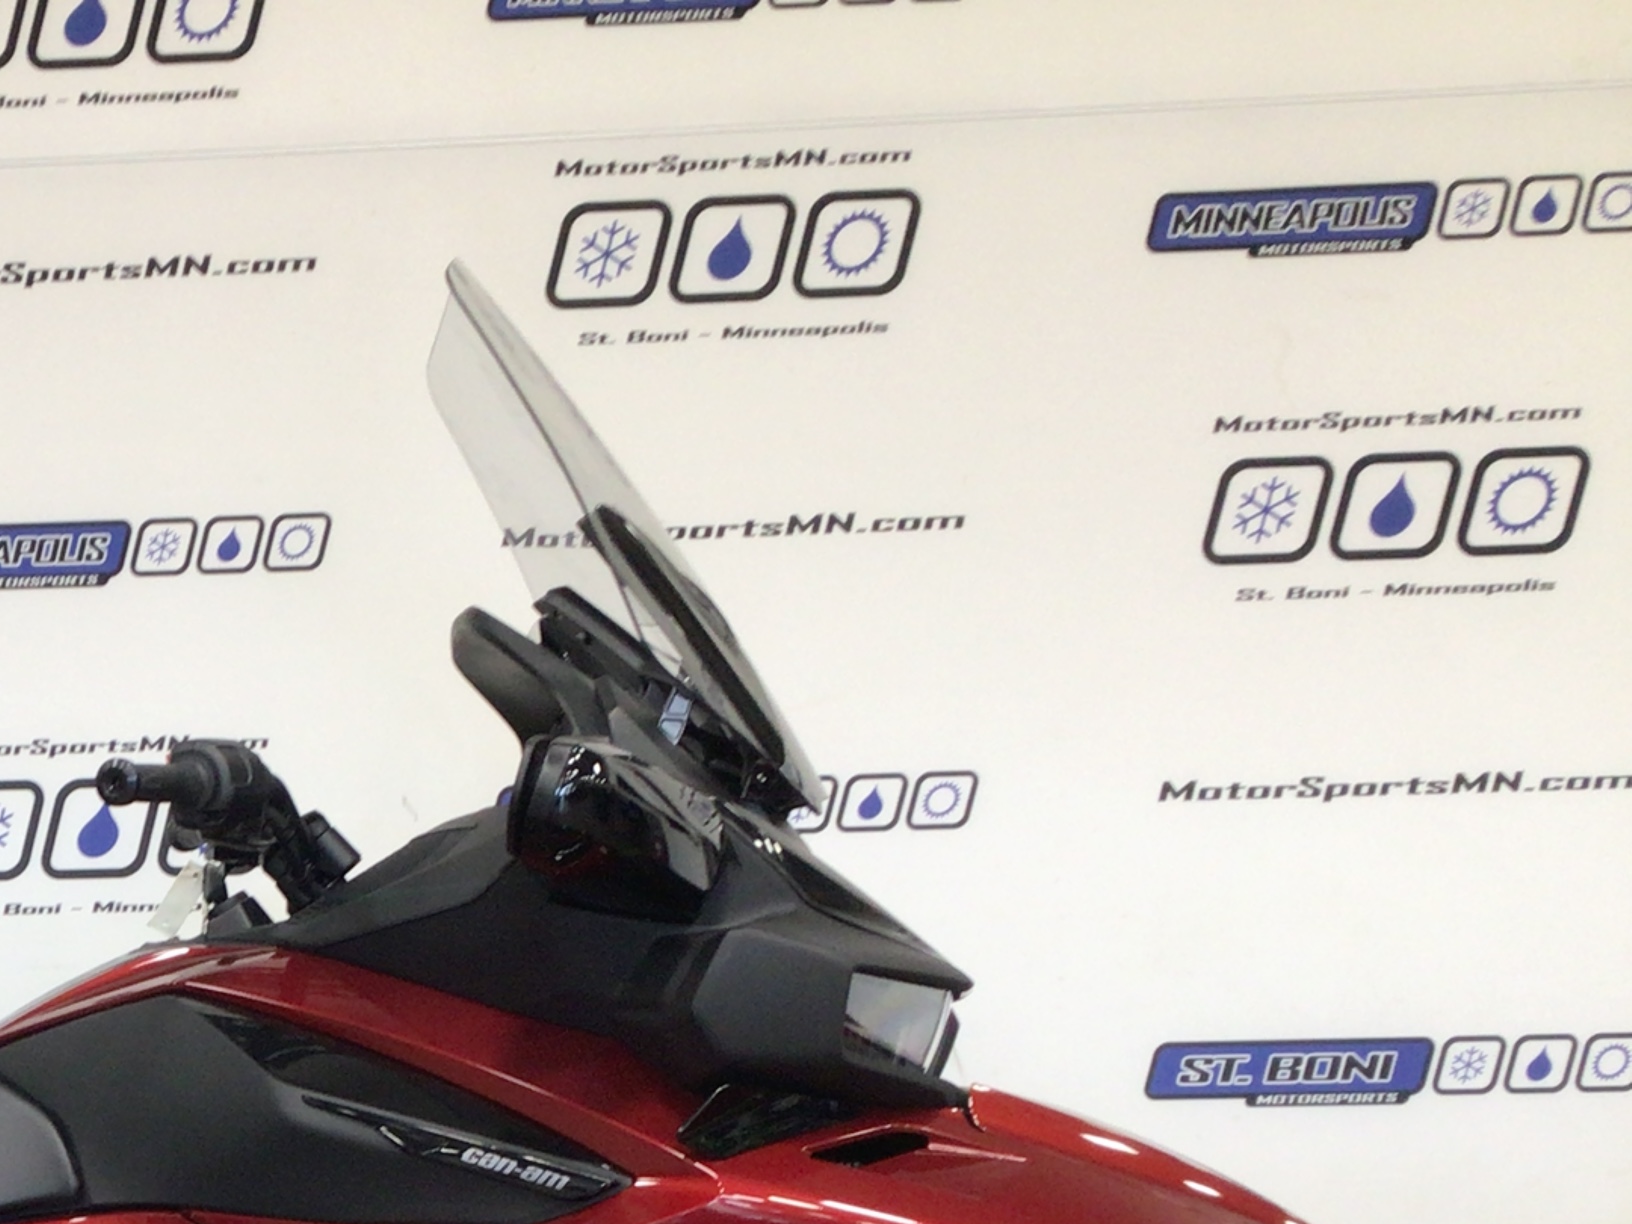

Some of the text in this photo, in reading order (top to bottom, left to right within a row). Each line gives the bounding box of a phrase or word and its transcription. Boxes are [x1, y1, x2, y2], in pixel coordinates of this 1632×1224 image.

[77, 85, 239, 106] Minneapolis
[554, 148, 912, 178] MotorSportsMN.com
[1167, 194, 1419, 240] MINNEAPOLIS
[1257, 238, 1405, 257] MOTORSPORTS
[577, 331, 613, 346] St.
[626, 329, 689, 344] Boni
[721, 320, 889, 340] Minneapolis
[1212, 405, 1582, 434] MotorSportsMN.com
[500, 510, 965, 550] MotortsMN.com
[1235, 587, 1273, 602] St.
[1285, 586, 1350, 601] Boni
[1382, 578, 1556, 597] Minneapolis
[3, 902, 62, 916] Boni
[1175, 1050, 1399, 1088] ST. BONI
[1255, 1091, 1400, 1106] MOTORSPORTS
[460, 1146, 571, 1192] can-am
